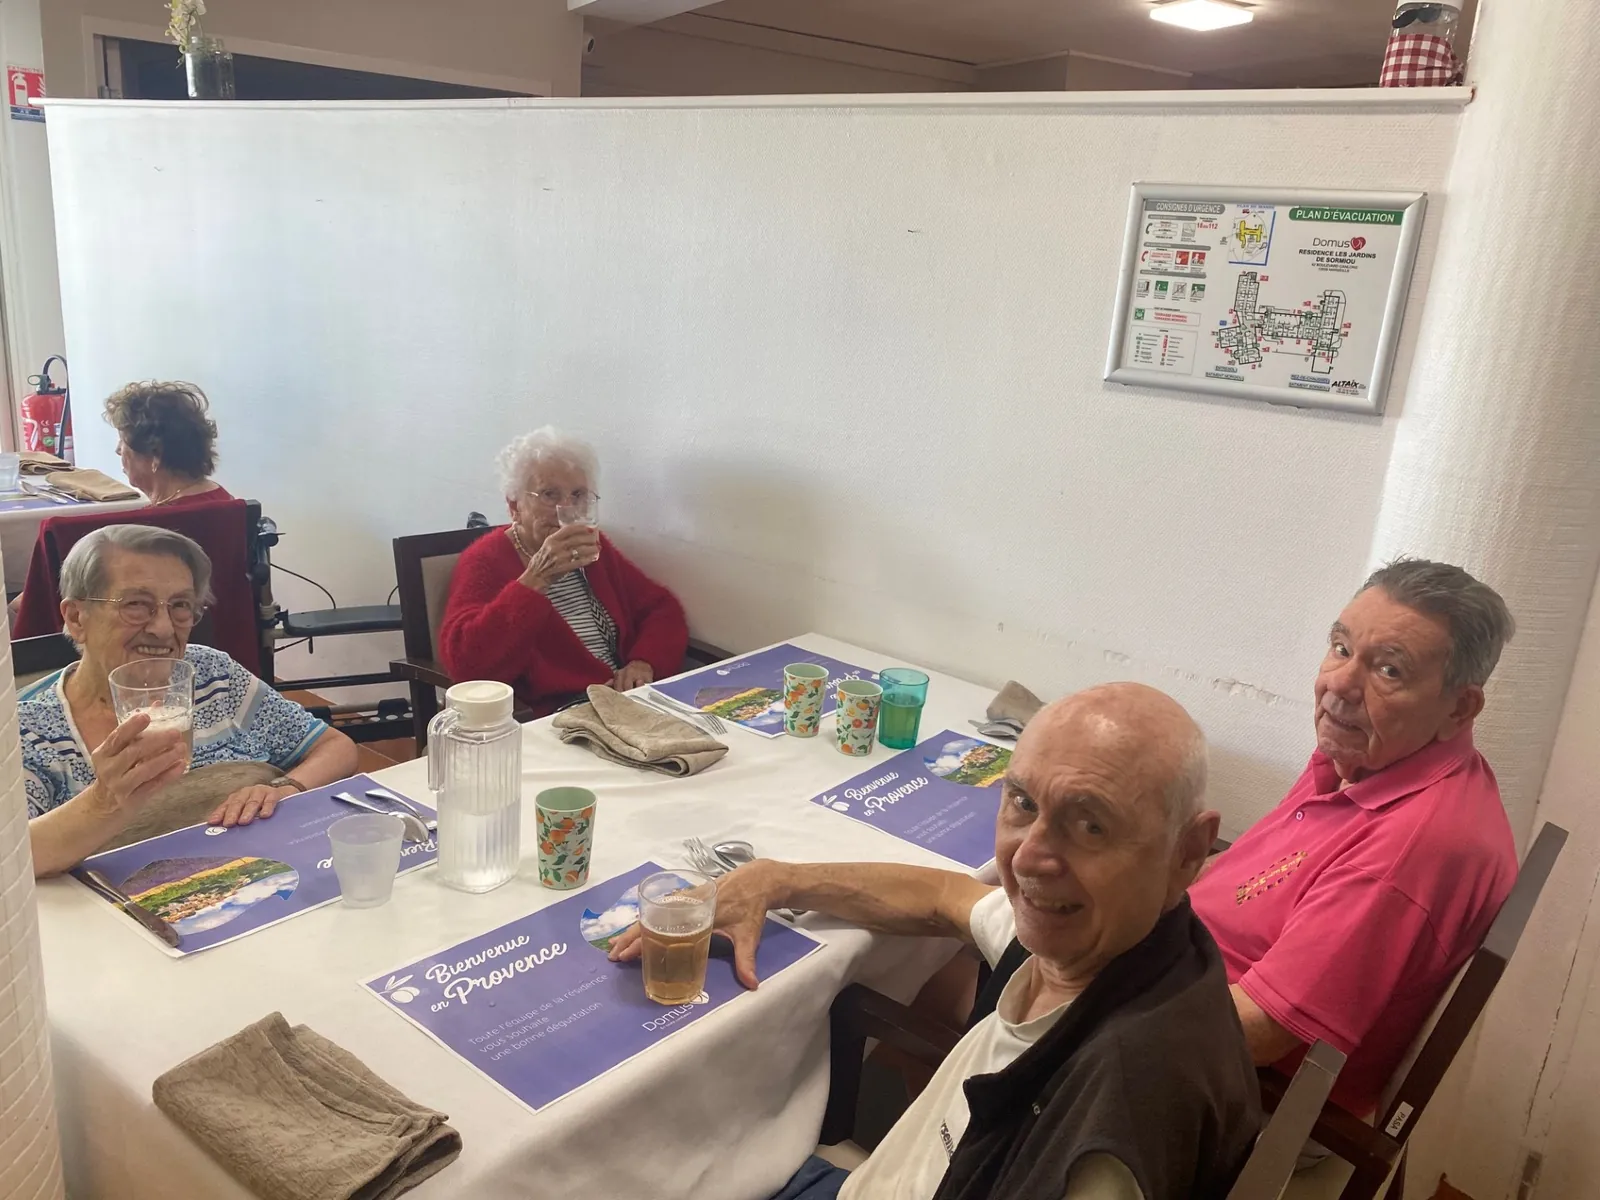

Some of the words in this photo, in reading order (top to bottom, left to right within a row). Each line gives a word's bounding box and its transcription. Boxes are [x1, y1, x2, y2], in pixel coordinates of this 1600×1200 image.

[1156, 203, 1189, 211] CONSIGNES
[1189, 204, 1221, 214] D'URGENCE
[1296, 210, 1321, 219] PLAN
[1323, 209, 1394, 222] D'ÉVACUATION
[1349, 251, 1376, 259] JARDINS
[844, 772, 899, 801] Bienvenue
[864, 777, 929, 812] Provence
[425, 935, 530, 984] Bienvenue
[430, 1001, 449, 1013] en
[443, 942, 567, 1005] Provence
[468, 1028, 500, 1045] Toute
[499, 1009, 538, 1031] l'équipe
[539, 1001, 553, 1011] de
[563, 973, 608, 999] résidence
[480, 1038, 507, 1053] vous
[506, 1016, 550, 1040] souhaite
[490, 1048, 512, 1061] une
[511, 1030, 546, 1050] bonne
[546, 1001, 604, 1034] dégustation
[1390, 1111, 1406, 1130] PASA
